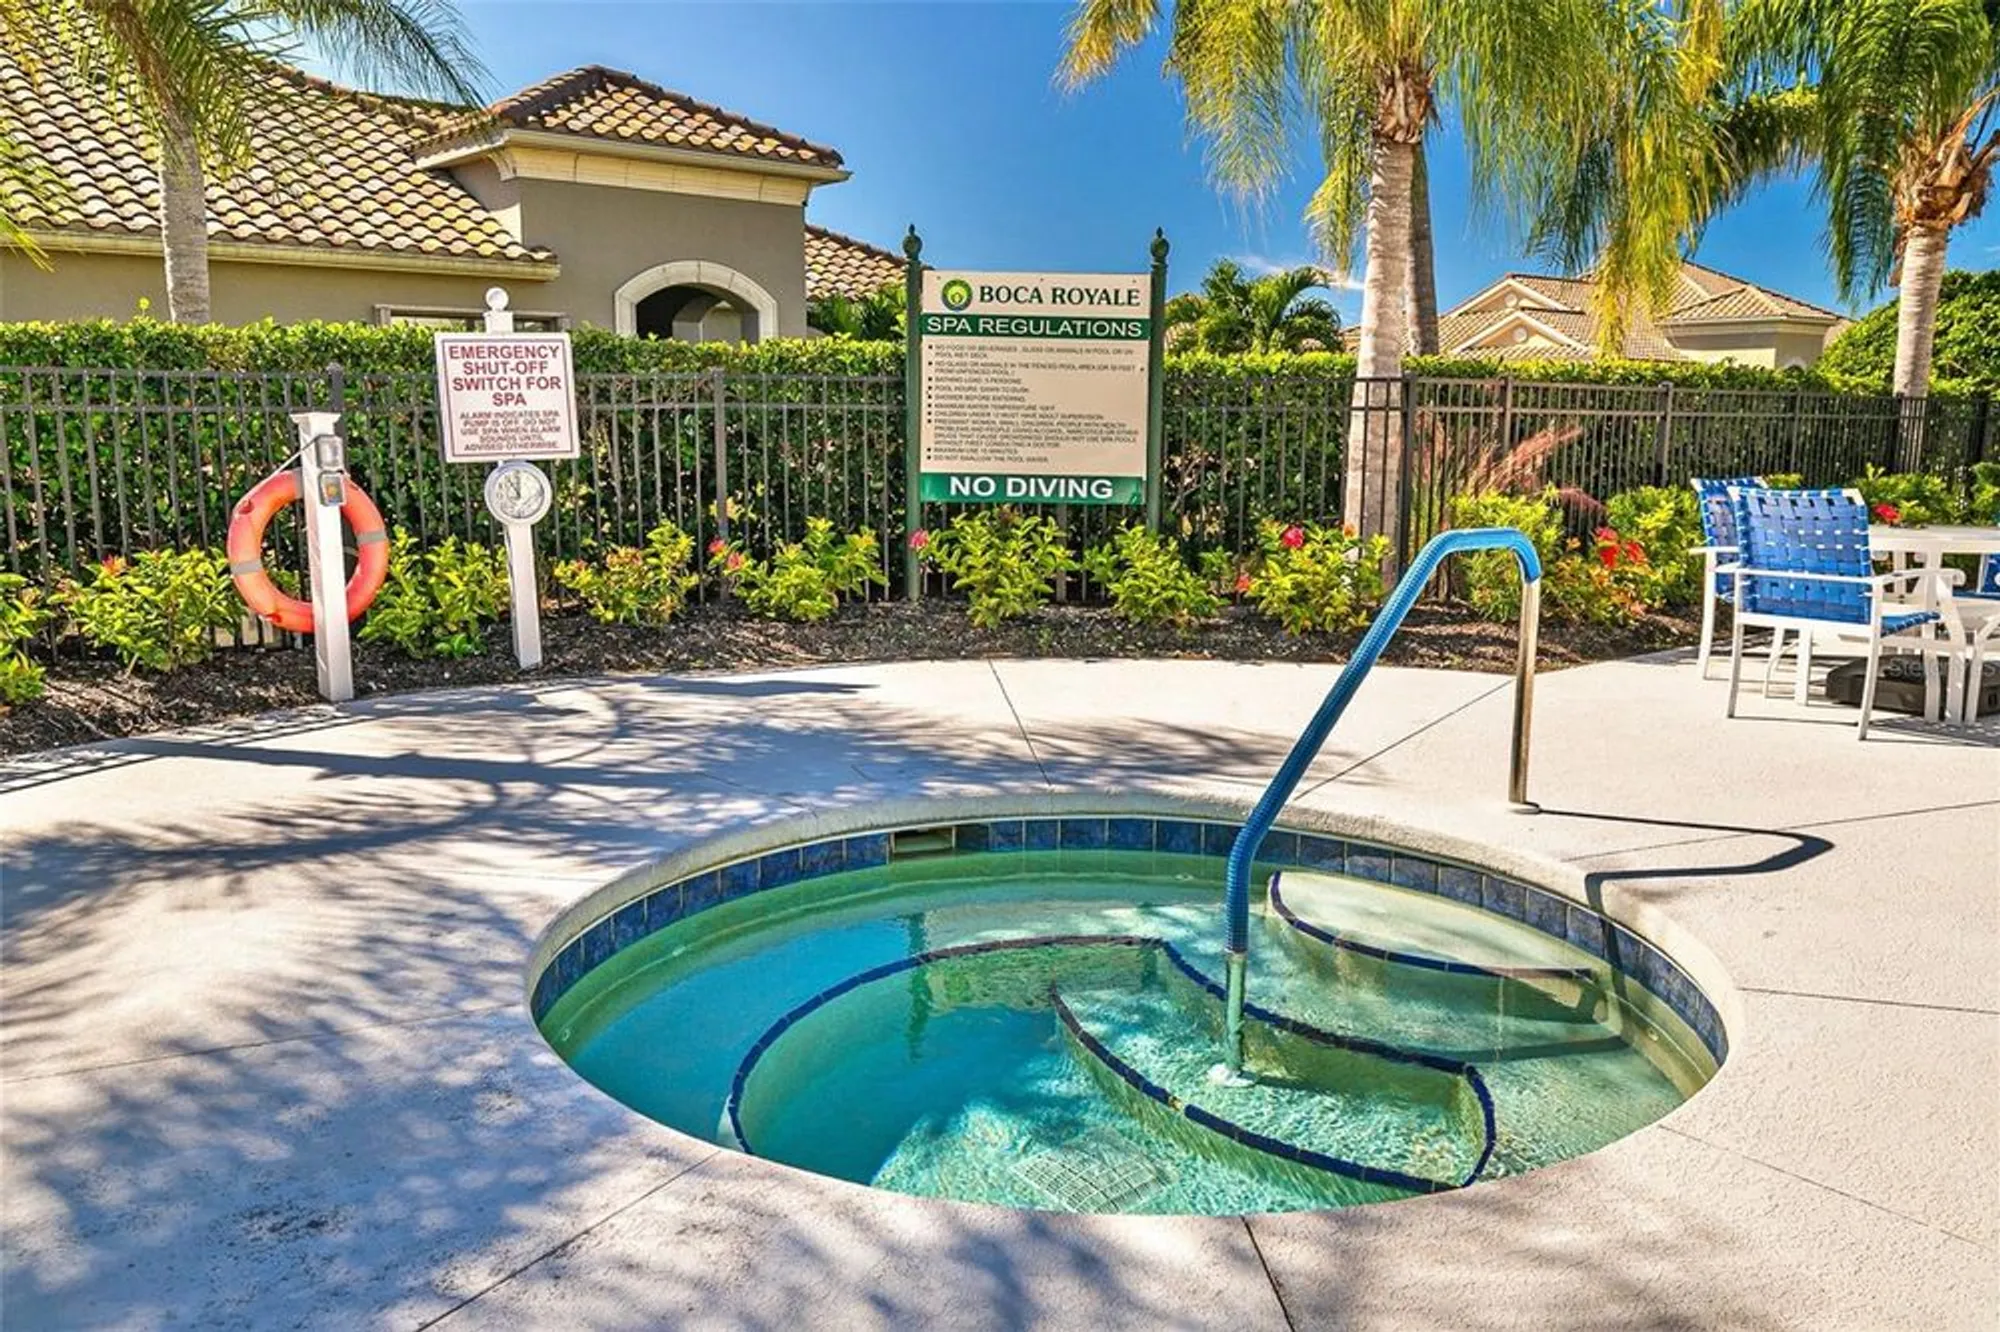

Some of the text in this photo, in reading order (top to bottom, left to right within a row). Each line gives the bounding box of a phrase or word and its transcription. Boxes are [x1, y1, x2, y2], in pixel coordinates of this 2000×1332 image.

[979, 286, 1141, 306] BOCA ROYALE
[927, 316, 1142, 337] SPA REGULATIONS
[448, 345, 559, 359] EMERGENCY
[463, 361, 548, 375] SHUT-OFF
[452, 376, 561, 392] SWITCH FOR
[492, 392, 527, 407] SPA
[950, 476, 1114, 499] NO DIVING
